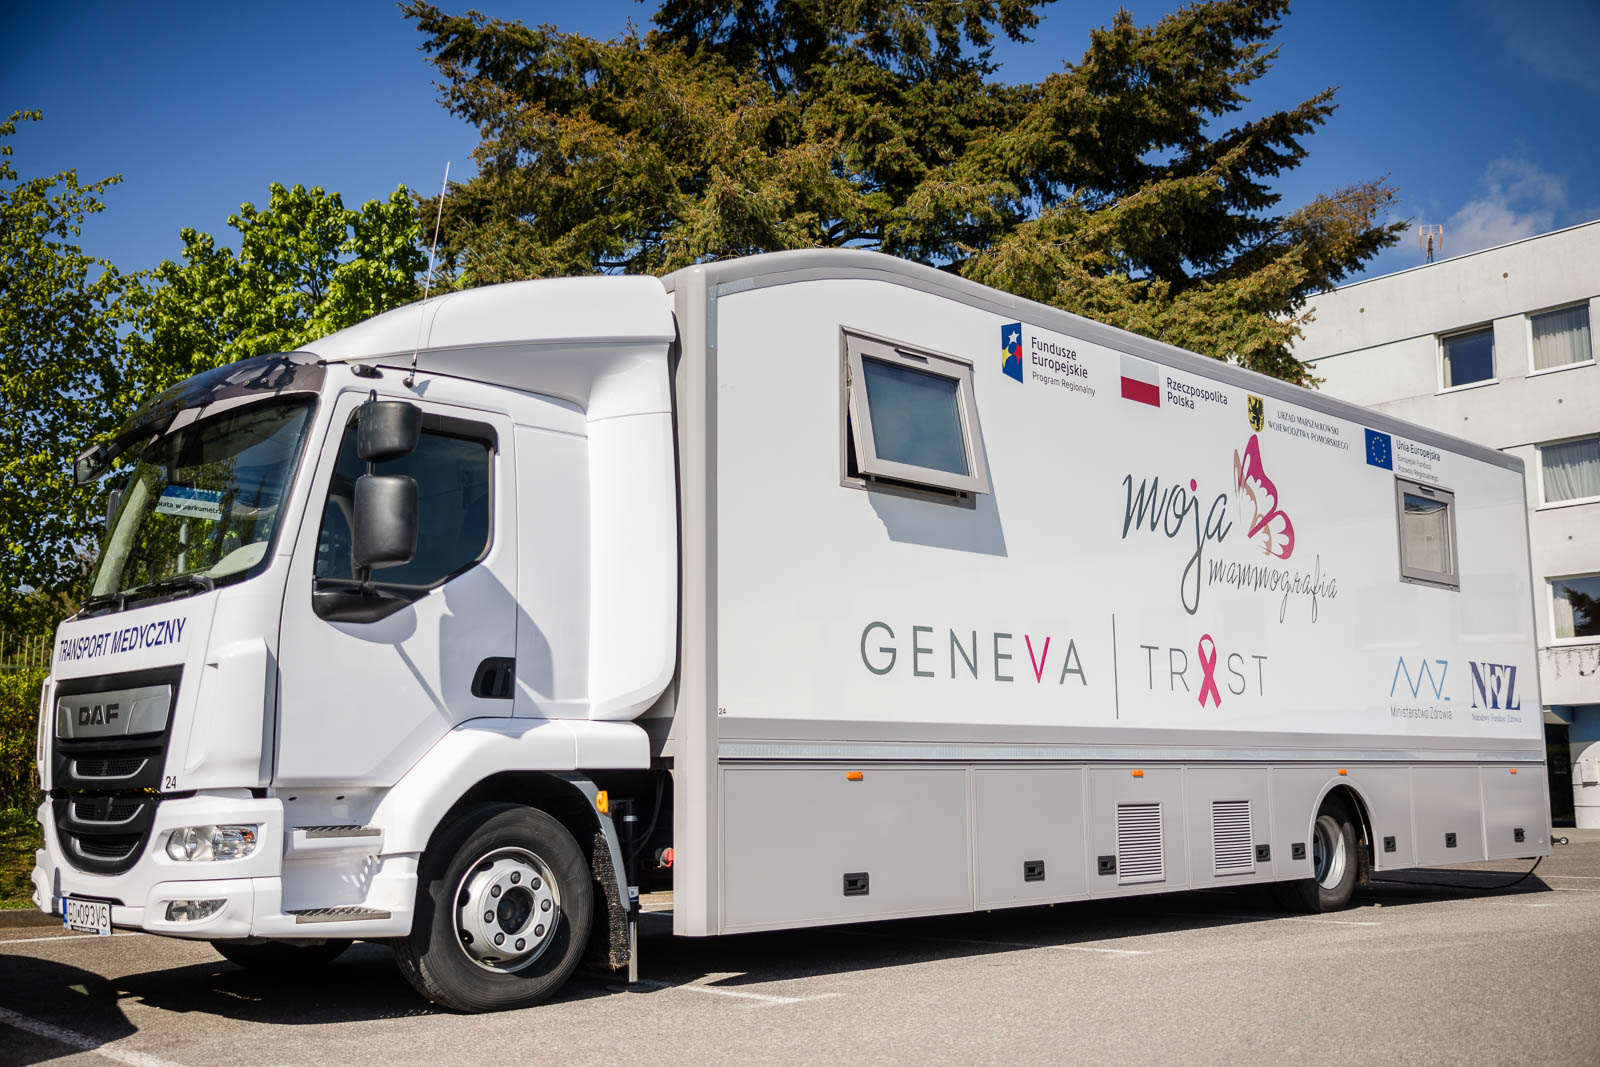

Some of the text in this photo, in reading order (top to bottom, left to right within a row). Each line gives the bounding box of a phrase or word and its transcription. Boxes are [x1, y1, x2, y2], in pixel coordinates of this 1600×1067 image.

[1031, 337, 1077, 361] Fundusze
[1032, 352, 1088, 379] Europejskie
[1032, 371, 1096, 398] Program Regionalny
[1166, 377, 1228, 406] Rzeczpospolita
[1167, 394, 1195, 410] Polska
[1311, 433, 1349, 451] POMORSKIEGO
[1396, 439, 1441, 461] Unia Europejska
[1208, 553, 1338, 623] mammografia
[58, 617, 187, 662] TRANSPORT MEDYCZNY
[860, 621, 1088, 686] GENEVA
[1468, 661, 1521, 711] NFZ
[78, 703, 120, 726] DAF
[718, 707, 727, 715] 24
[1390, 706, 1452, 720] Ministerstwo Zdrowia
[165, 775, 177, 789] 24
